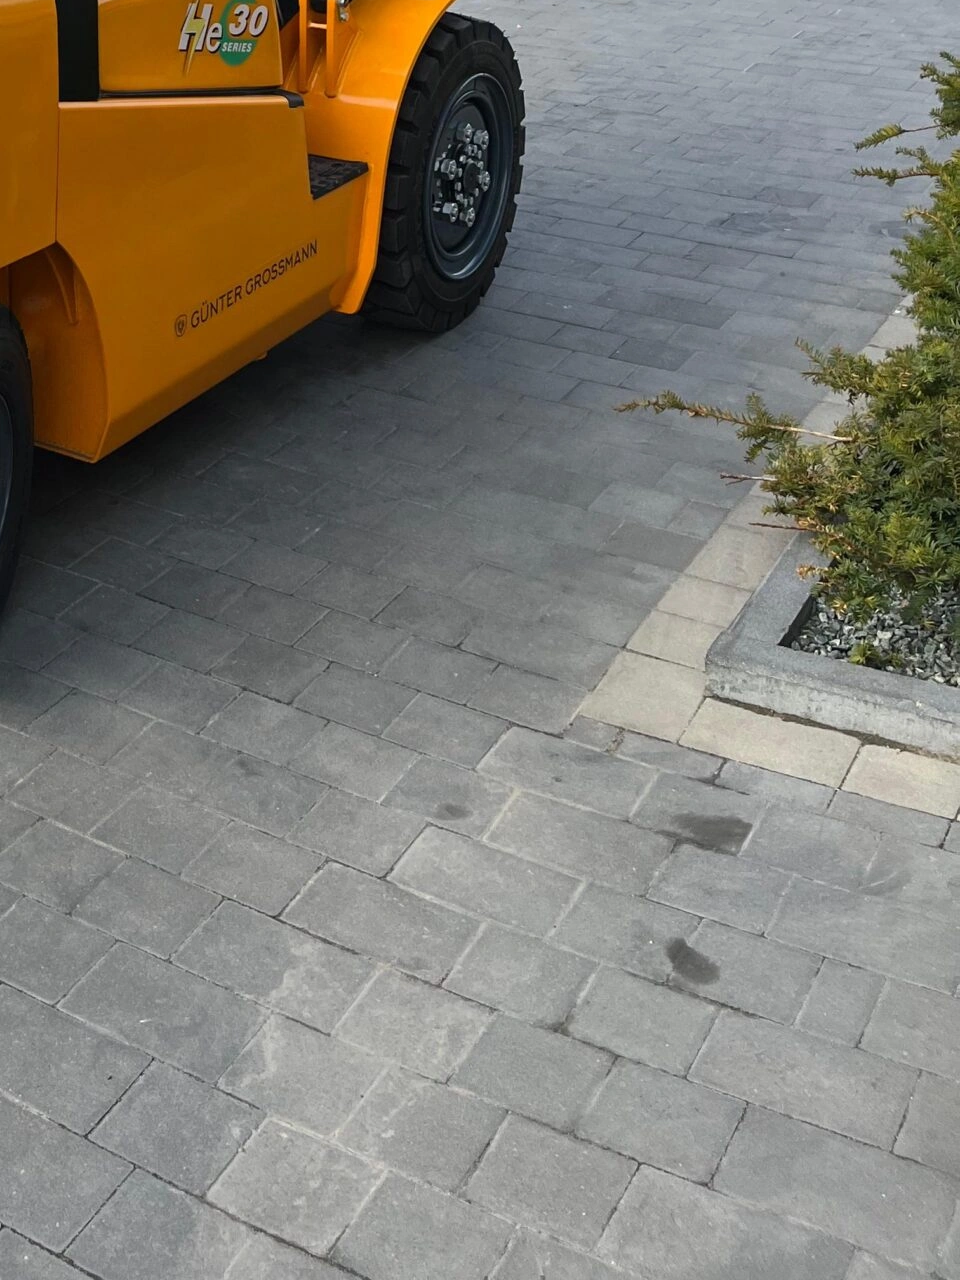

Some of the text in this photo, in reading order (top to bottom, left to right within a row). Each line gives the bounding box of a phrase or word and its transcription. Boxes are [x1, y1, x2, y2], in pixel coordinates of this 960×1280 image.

[228, 3, 269, 37] 30
[221, 41, 253, 53] SERIES
[190, 239, 318, 328] GÜNTER GROSSMANN
